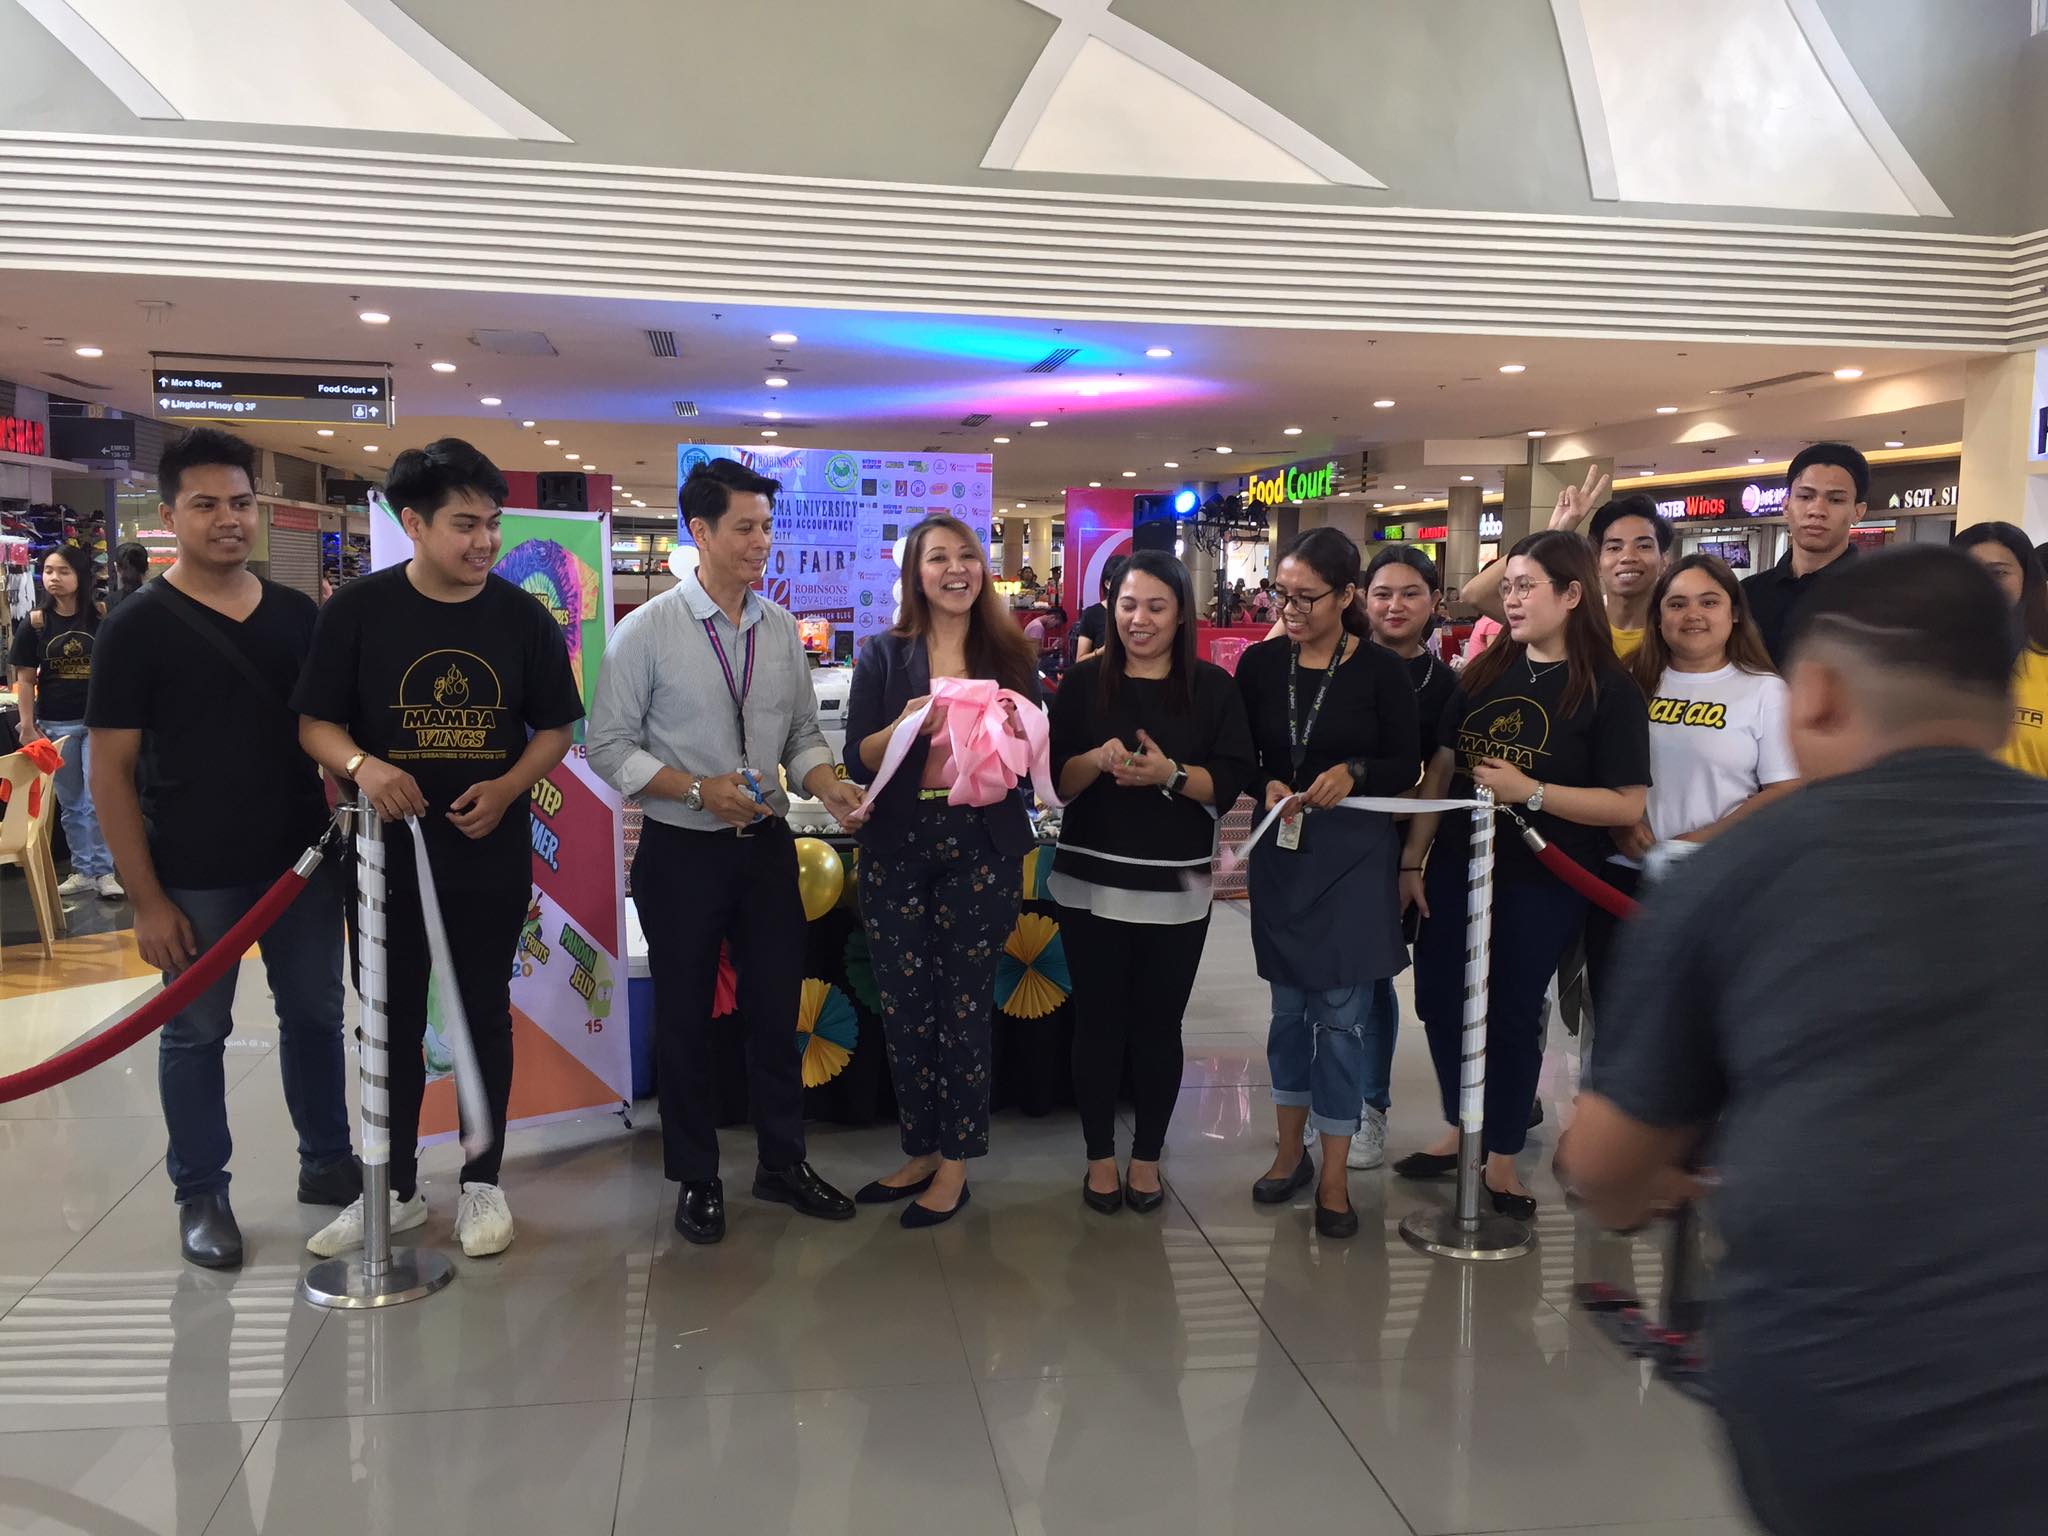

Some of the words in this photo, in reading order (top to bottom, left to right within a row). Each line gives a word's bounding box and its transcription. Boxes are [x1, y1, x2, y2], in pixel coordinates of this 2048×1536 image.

[171, 379, 193, 387] More
[194, 379, 222, 389] Shops
[318, 385, 341, 393] Food
[343, 385, 366, 394] Court
[171, 400, 206, 411] Lingkod
[208, 401, 232, 412] Pinoy
[245, 403, 256, 411] 3F
[758, 455, 802, 468] ROBINSONS
[1248, 469, 1285, 506] Food
[1287, 466, 1333, 502] Court
[1686, 496, 1725, 516] Wings
[1904, 489, 1937, 508] SGT.
[796, 500, 858, 518] UNIVERSITY
[777, 519, 792, 529] AND
[796, 519, 853, 532] ACCOUNTANCY
[774, 531, 791, 540] CITY
[795, 584, 848, 594] ROBINSONS
[794, 596, 848, 606] NOVALICHES
[402, 709, 496, 728] MAMBA
[1683, 702, 1726, 729] CLO.
[416, 730, 486, 747] WINGS
[1459, 735, 1532, 769] MAMBA
[525, 932, 549, 964] FRUITS
[559, 922, 598, 974] PANDAN
[569, 964, 597, 1000] JELLY
[585, 1019, 603, 1034] 15
